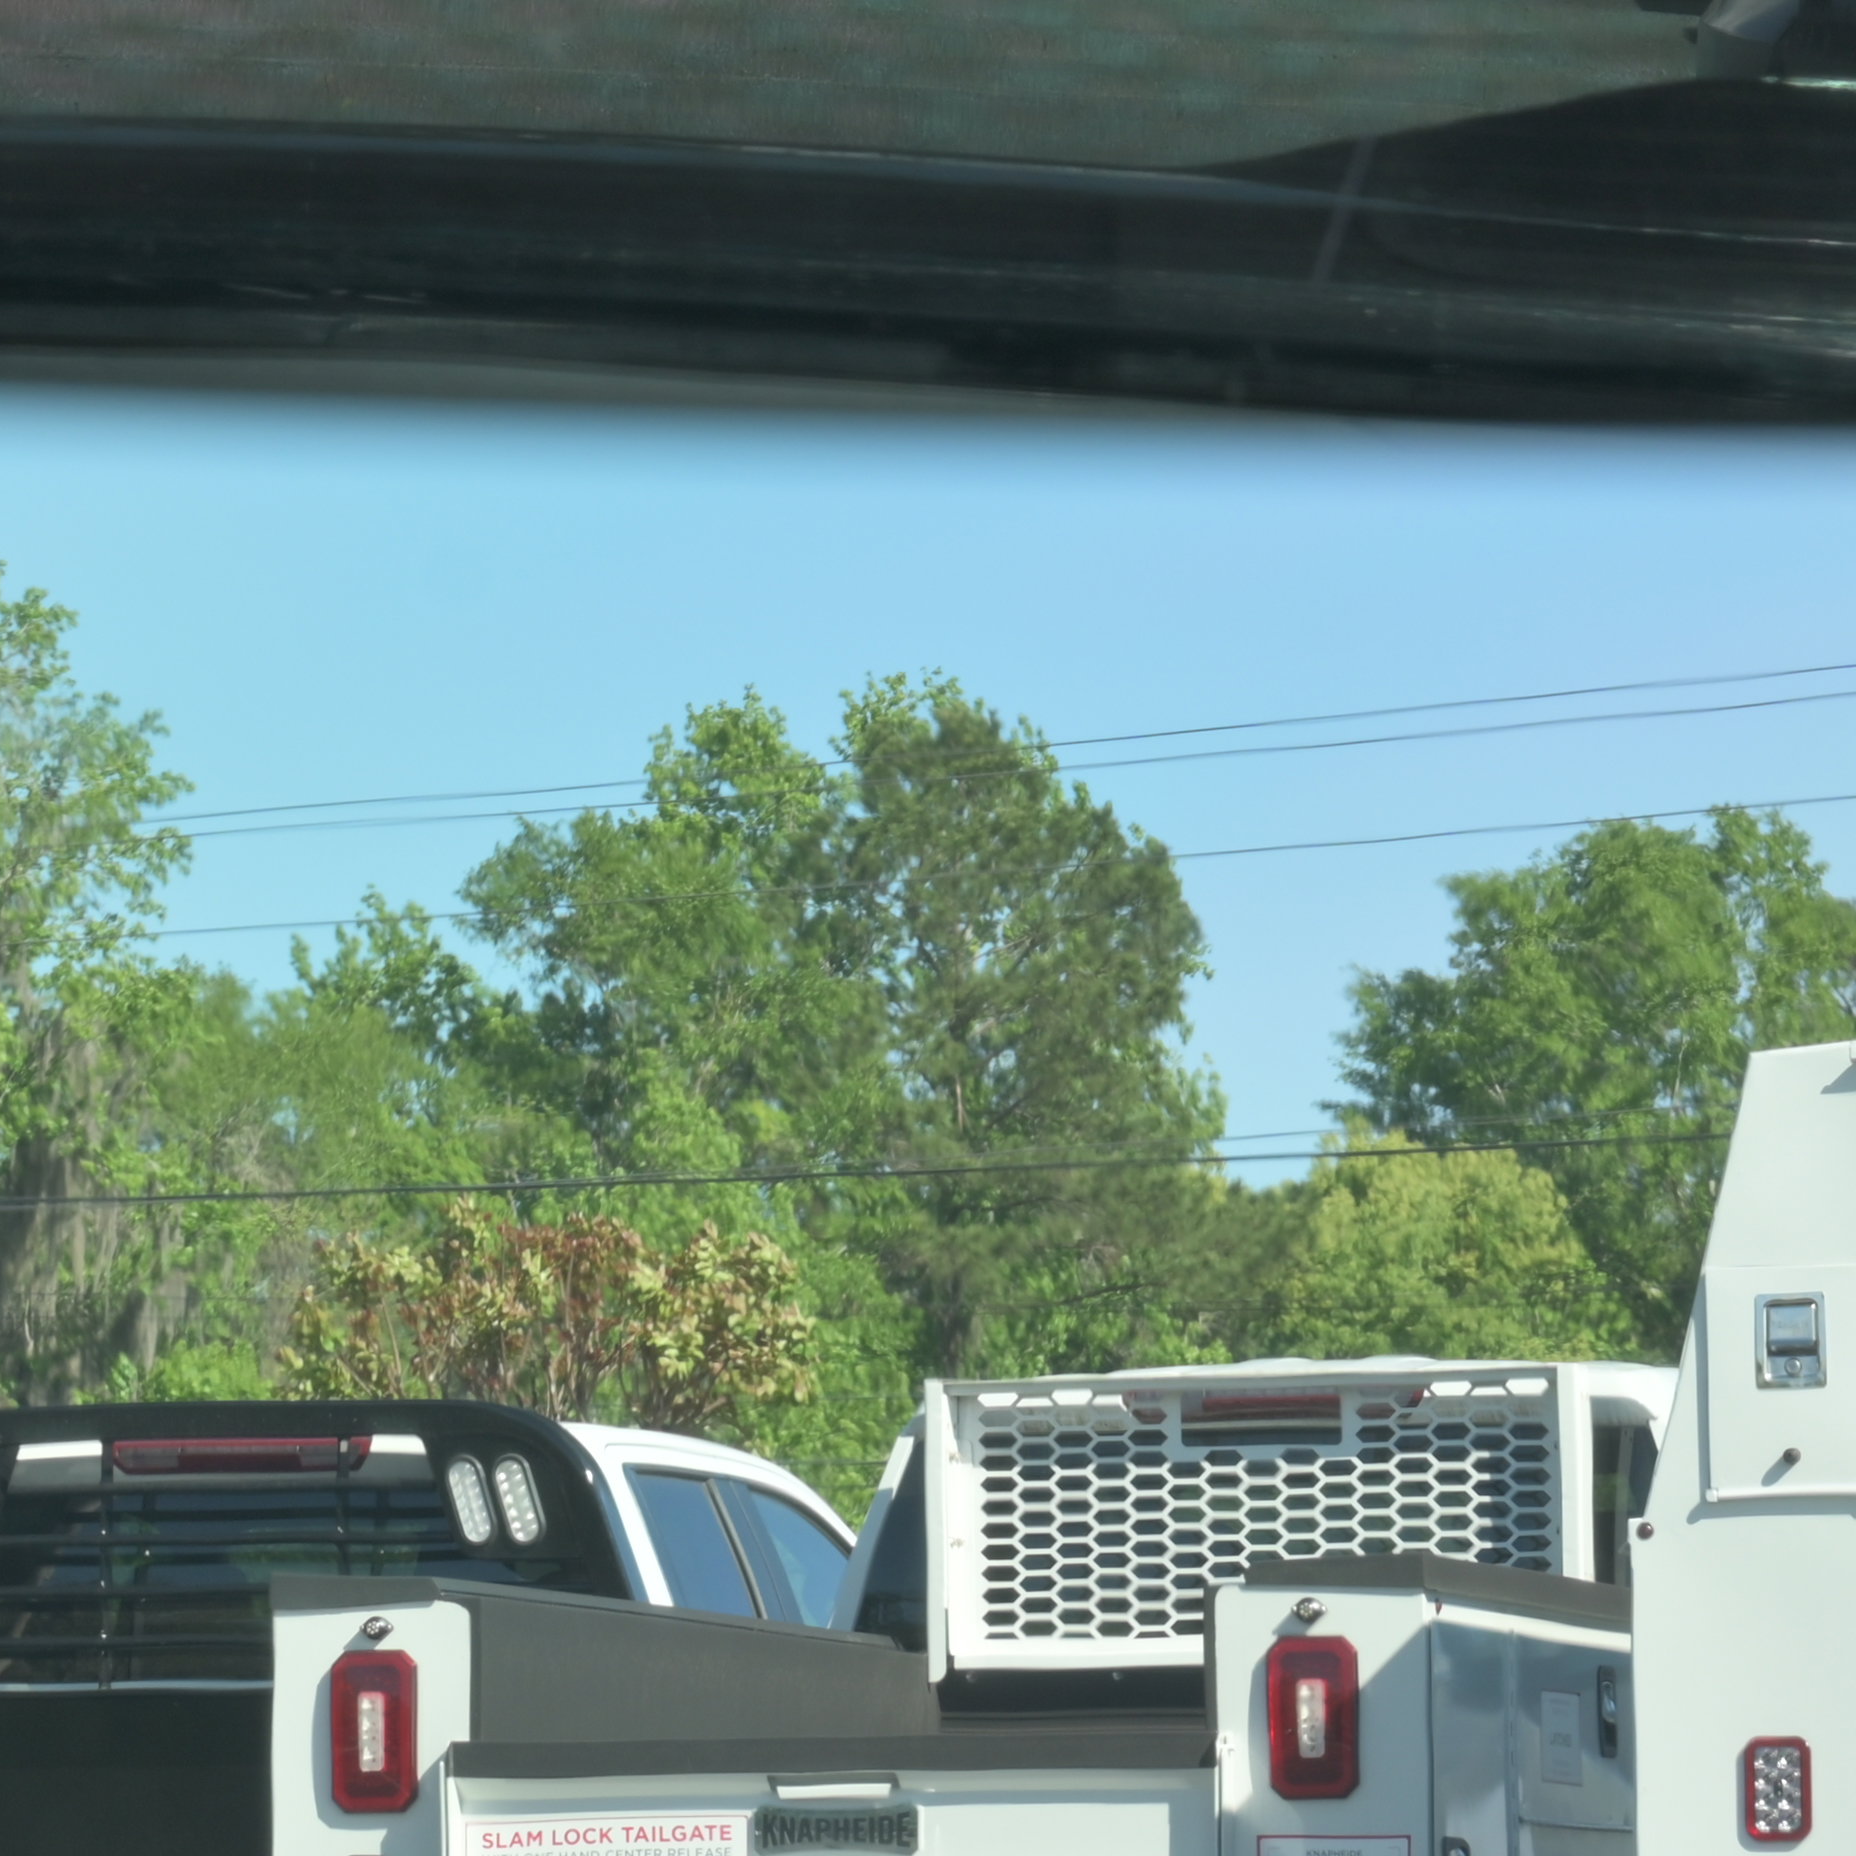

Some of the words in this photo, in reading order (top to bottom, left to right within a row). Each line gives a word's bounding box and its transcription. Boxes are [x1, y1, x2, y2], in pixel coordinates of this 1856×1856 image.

[482, 1829, 543, 1850] SLAM
[551, 1827, 613, 1846] LOCK
[621, 1824, 733, 1844] TAILGATE
[761, 1811, 912, 1849] KNAPHEIDE
